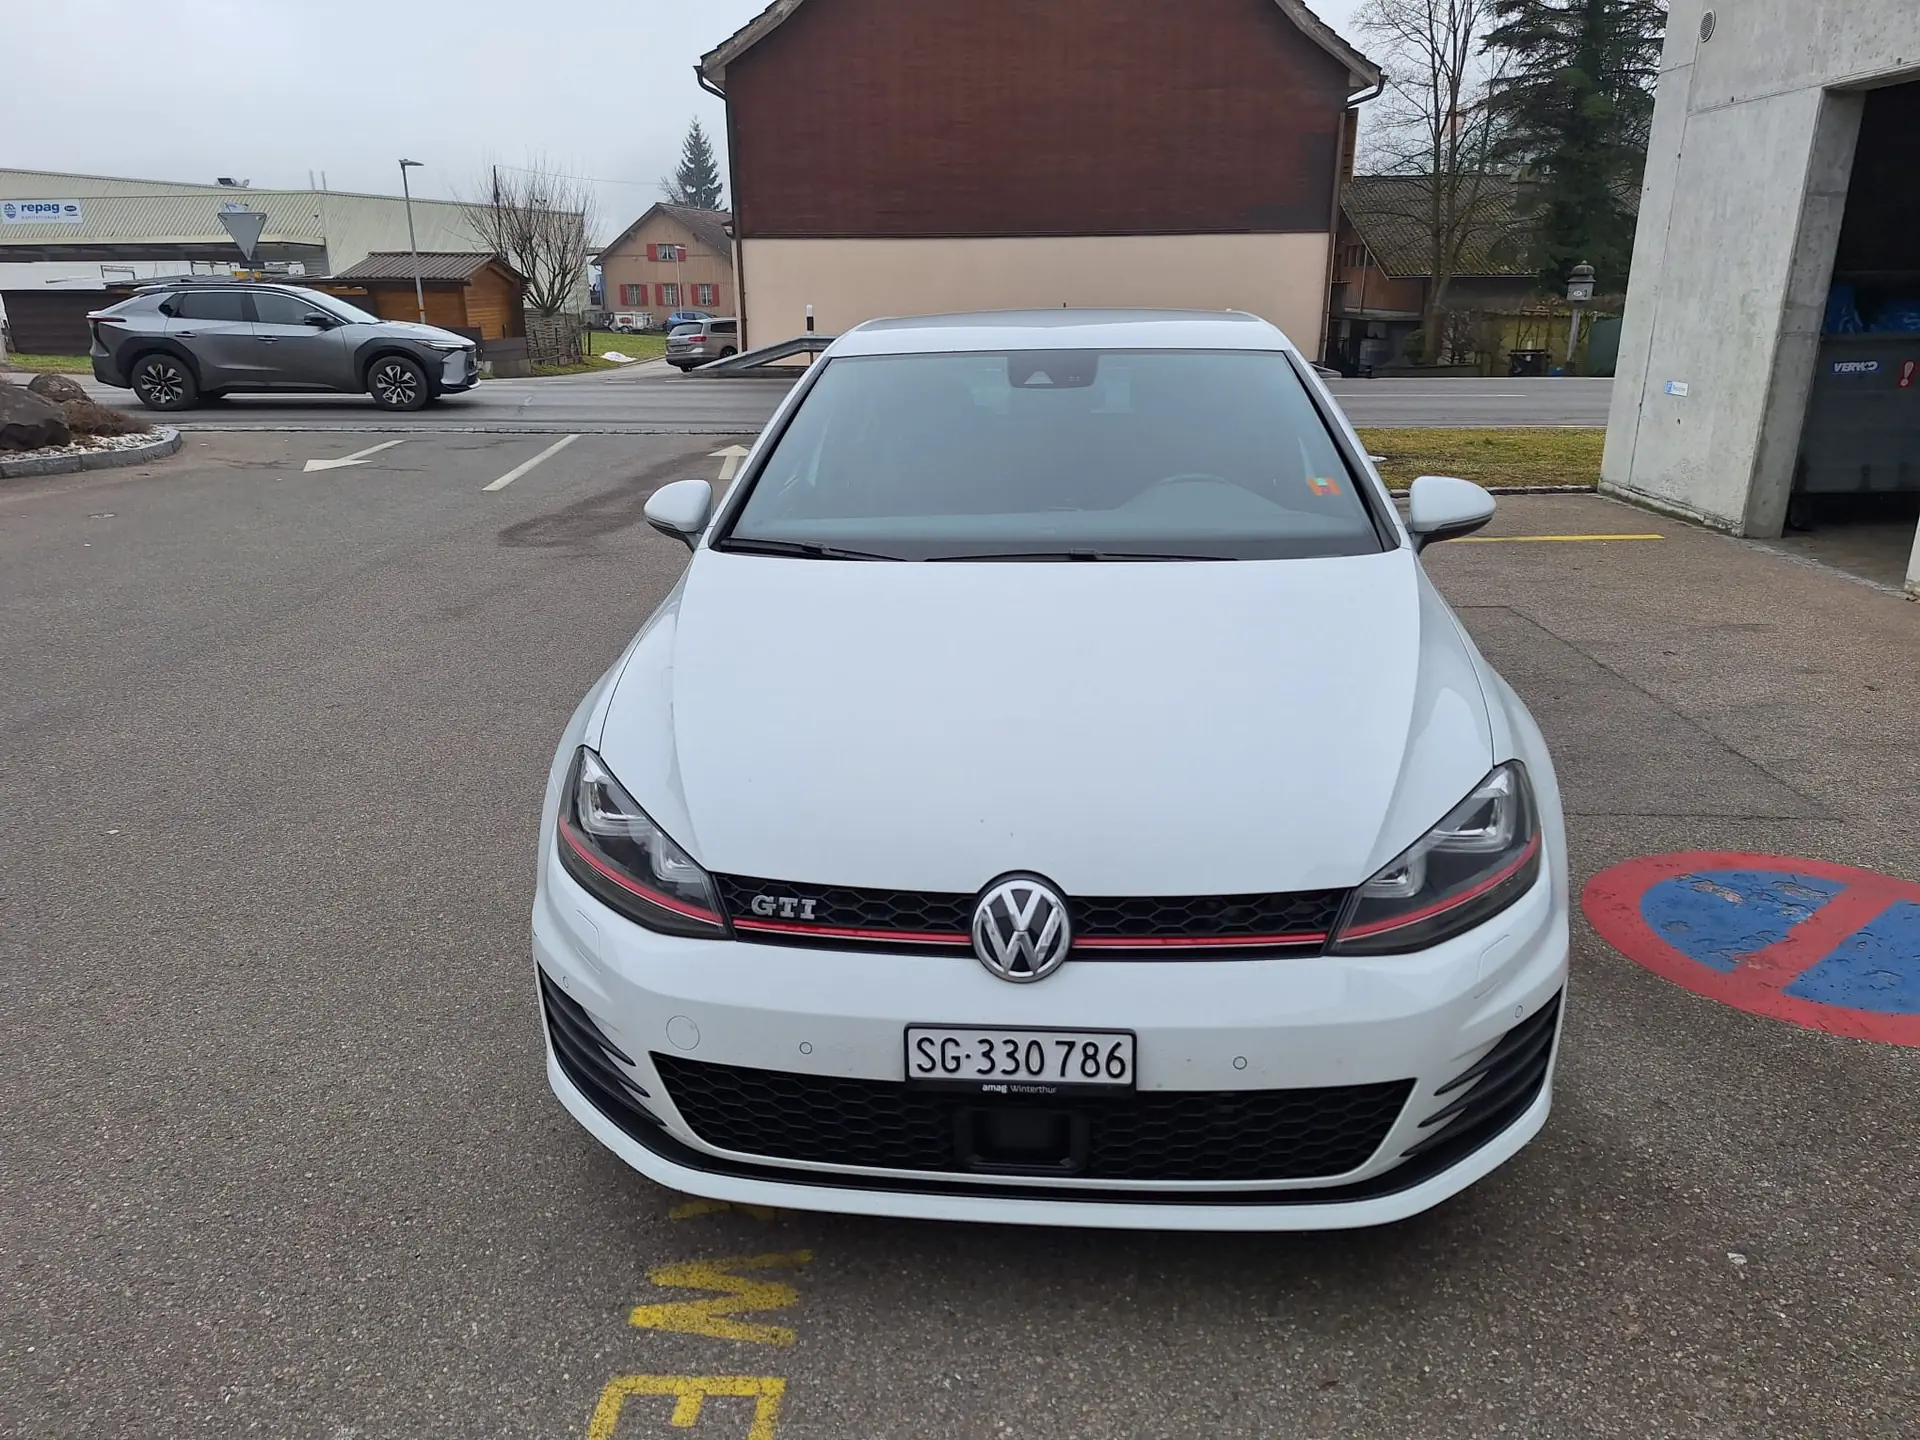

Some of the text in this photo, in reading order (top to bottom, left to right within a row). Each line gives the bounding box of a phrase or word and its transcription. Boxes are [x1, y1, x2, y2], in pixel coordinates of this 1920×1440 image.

[21, 203, 60, 213] repag
[751, 894, 817, 920] GTI
[975, 879, 1067, 979] VW
[982, 1084, 1057, 1094] amag Winterthur
